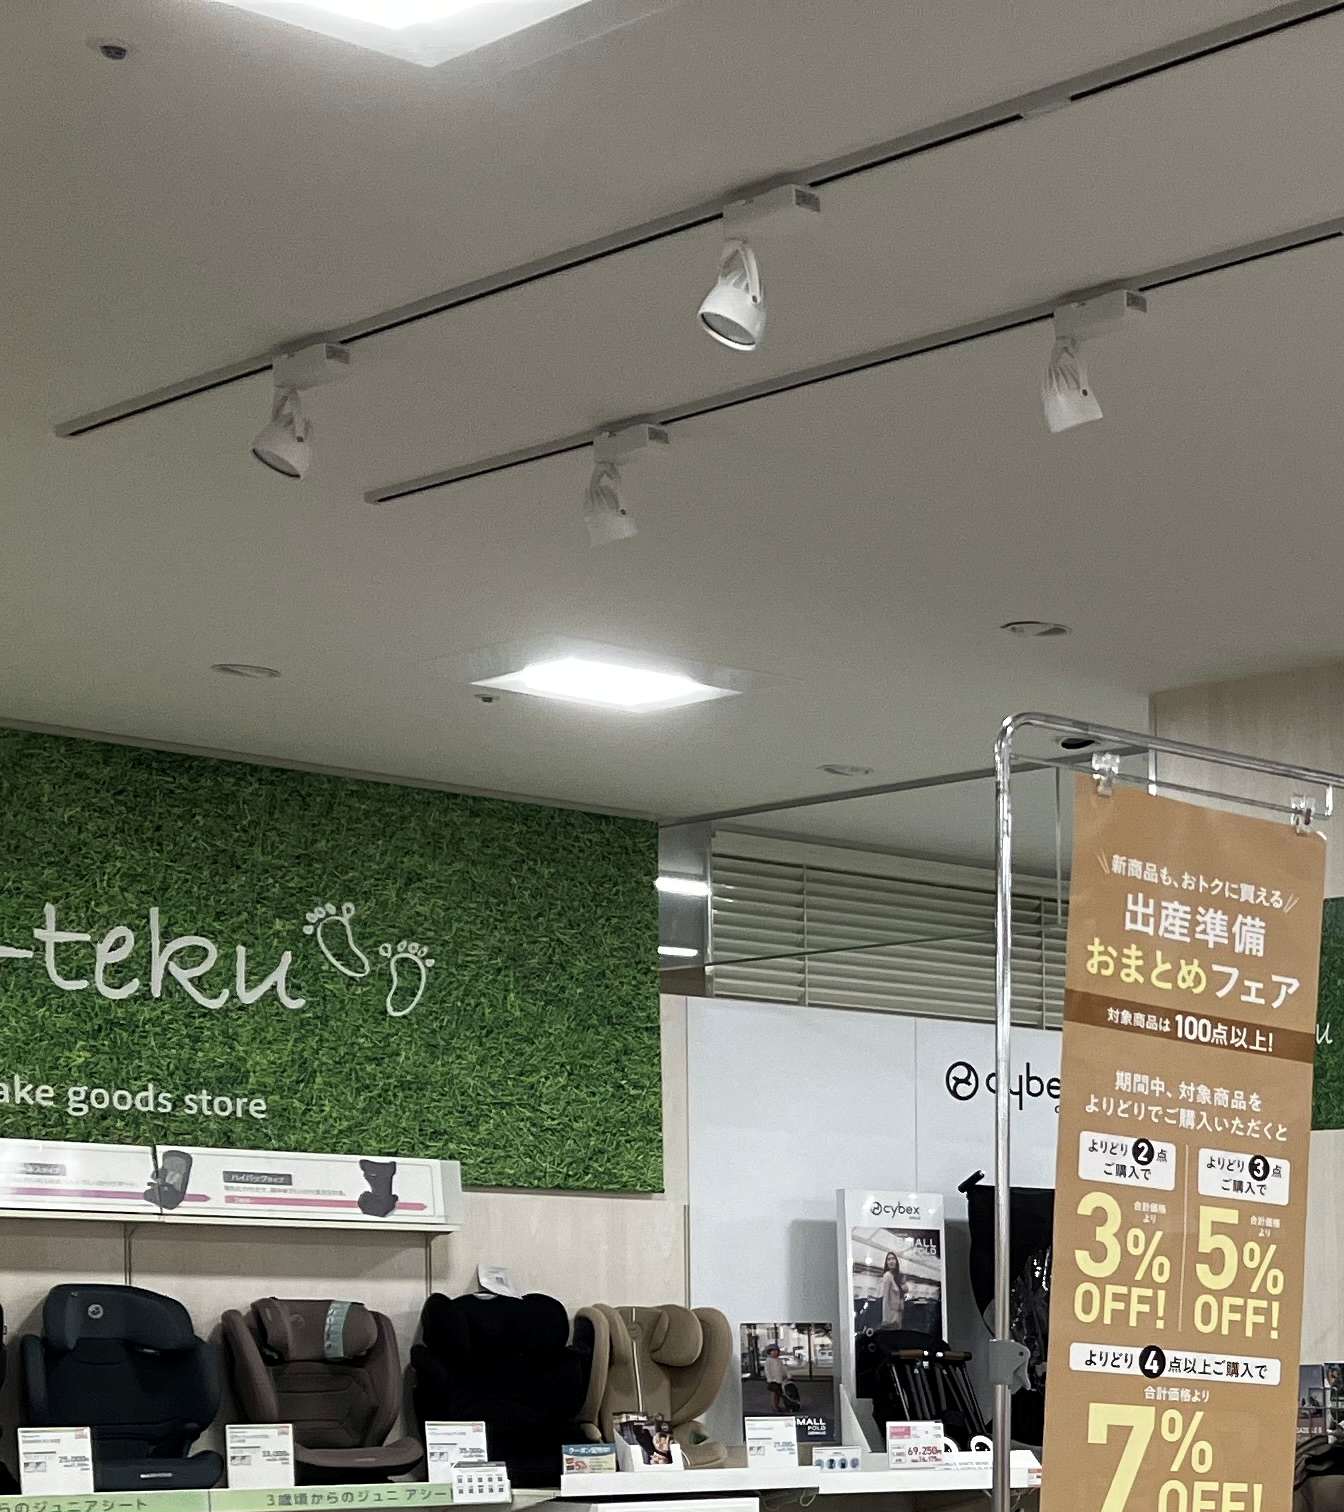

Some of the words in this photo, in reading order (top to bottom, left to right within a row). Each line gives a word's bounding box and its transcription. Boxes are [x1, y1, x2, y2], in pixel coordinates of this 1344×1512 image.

[1111, 854, 1284, 910] 新商品も、おトクに買える
[1124, 892, 1267, 957] 出産準備
[1086, 937, 1300, 1009] おまとめフェア
[67, 1083, 172, 1116] goods
[183, 1088, 267, 1119] store
[985, 1062, 1061, 1110] cybe
[1115, 1070, 1263, 1112] 期間中、対象商品を
[1084, 1094, 1288, 1142] よりどりでご購入いただくと
[1103, 1162, 1152, 1181] ご購入で
[1221, 1178, 1267, 1196] ご購入で
[883, 1201, 920, 1218] cybex
[1073, 1282, 1166, 1329] OFF!
[1193, 1294, 1280, 1340] OFF!
[1143, 1385, 1211, 1403] 合計価格より
[796, 1417, 827, 1426] MALL
